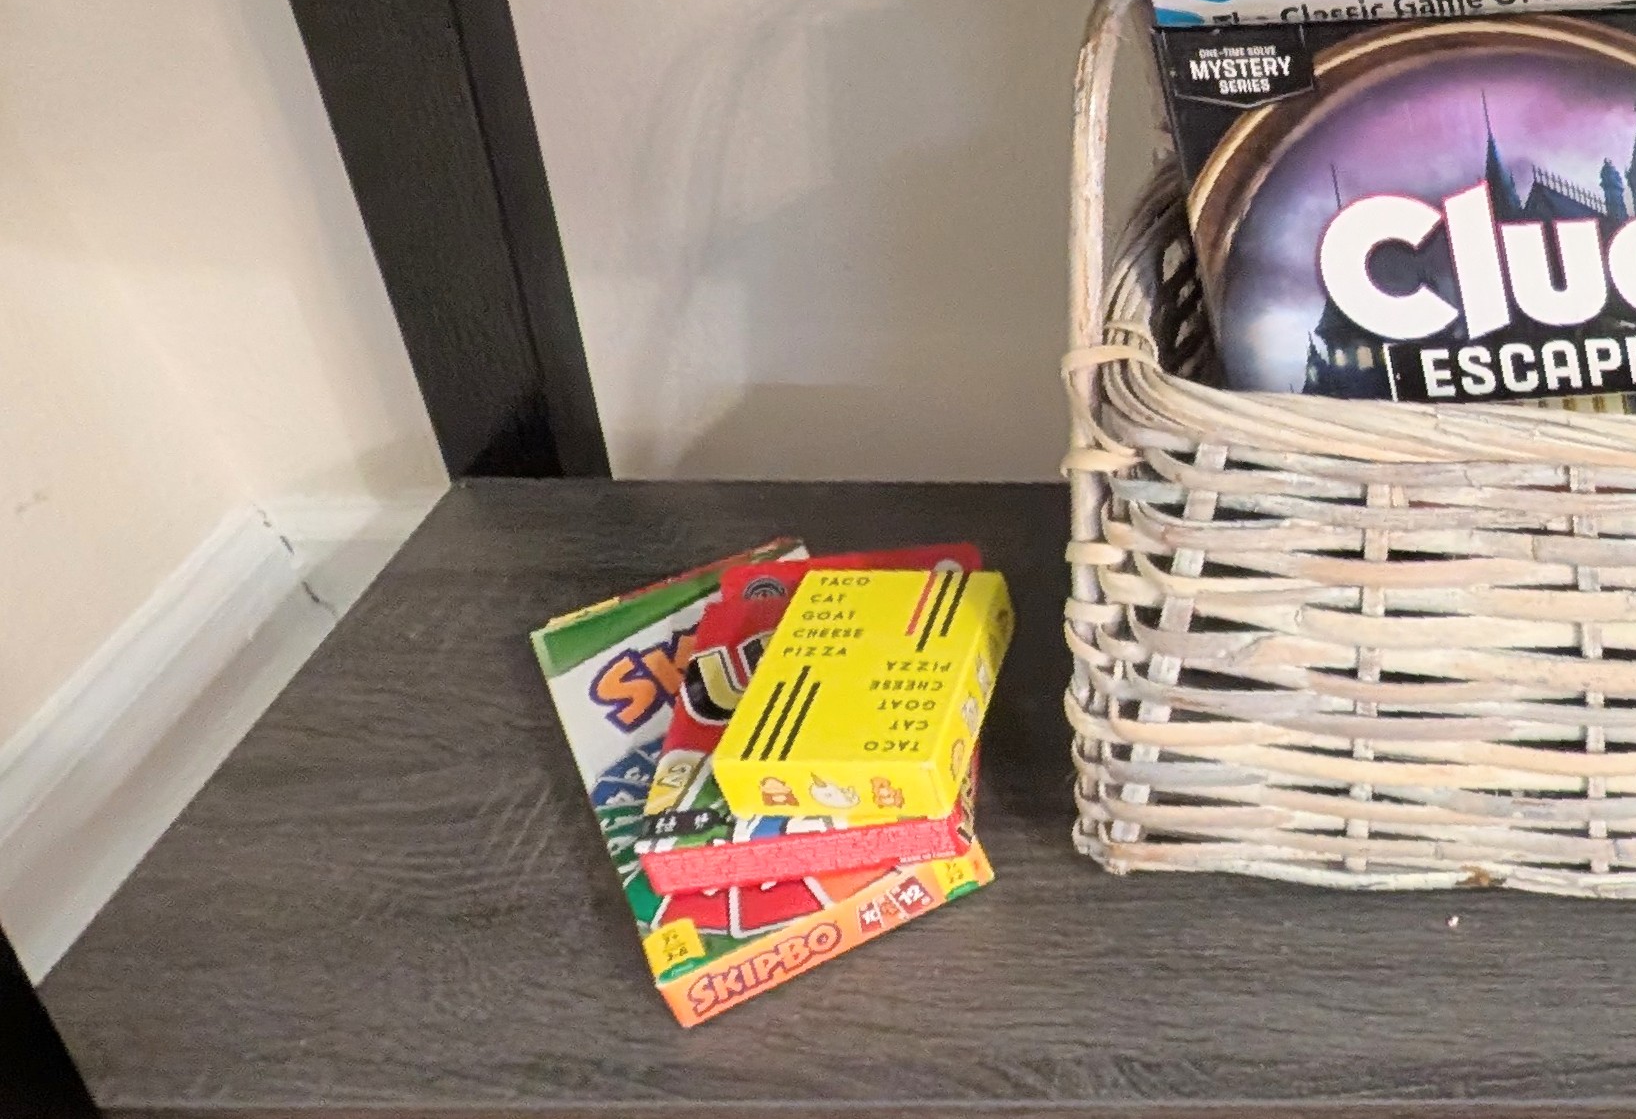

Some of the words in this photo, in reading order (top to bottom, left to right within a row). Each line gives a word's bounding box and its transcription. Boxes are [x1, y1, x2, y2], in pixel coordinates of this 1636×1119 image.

[1189, 55, 1291, 81] MYSTERY
[1218, 78, 1271, 95] SERIES
[820, 576, 871, 586] TACO
[810, 593, 847, 603] CAT
[802, 610, 856, 621] GOAT
[793, 628, 865, 639] CHEESE
[783, 646, 848, 657] PIZZA
[886, 660, 952, 672] PIZZA
[869, 679, 944, 691] CHEESE
[877, 699, 937, 711] GOAT
[889, 719, 929, 731] CAT
[863, 740, 921, 752] TACO
